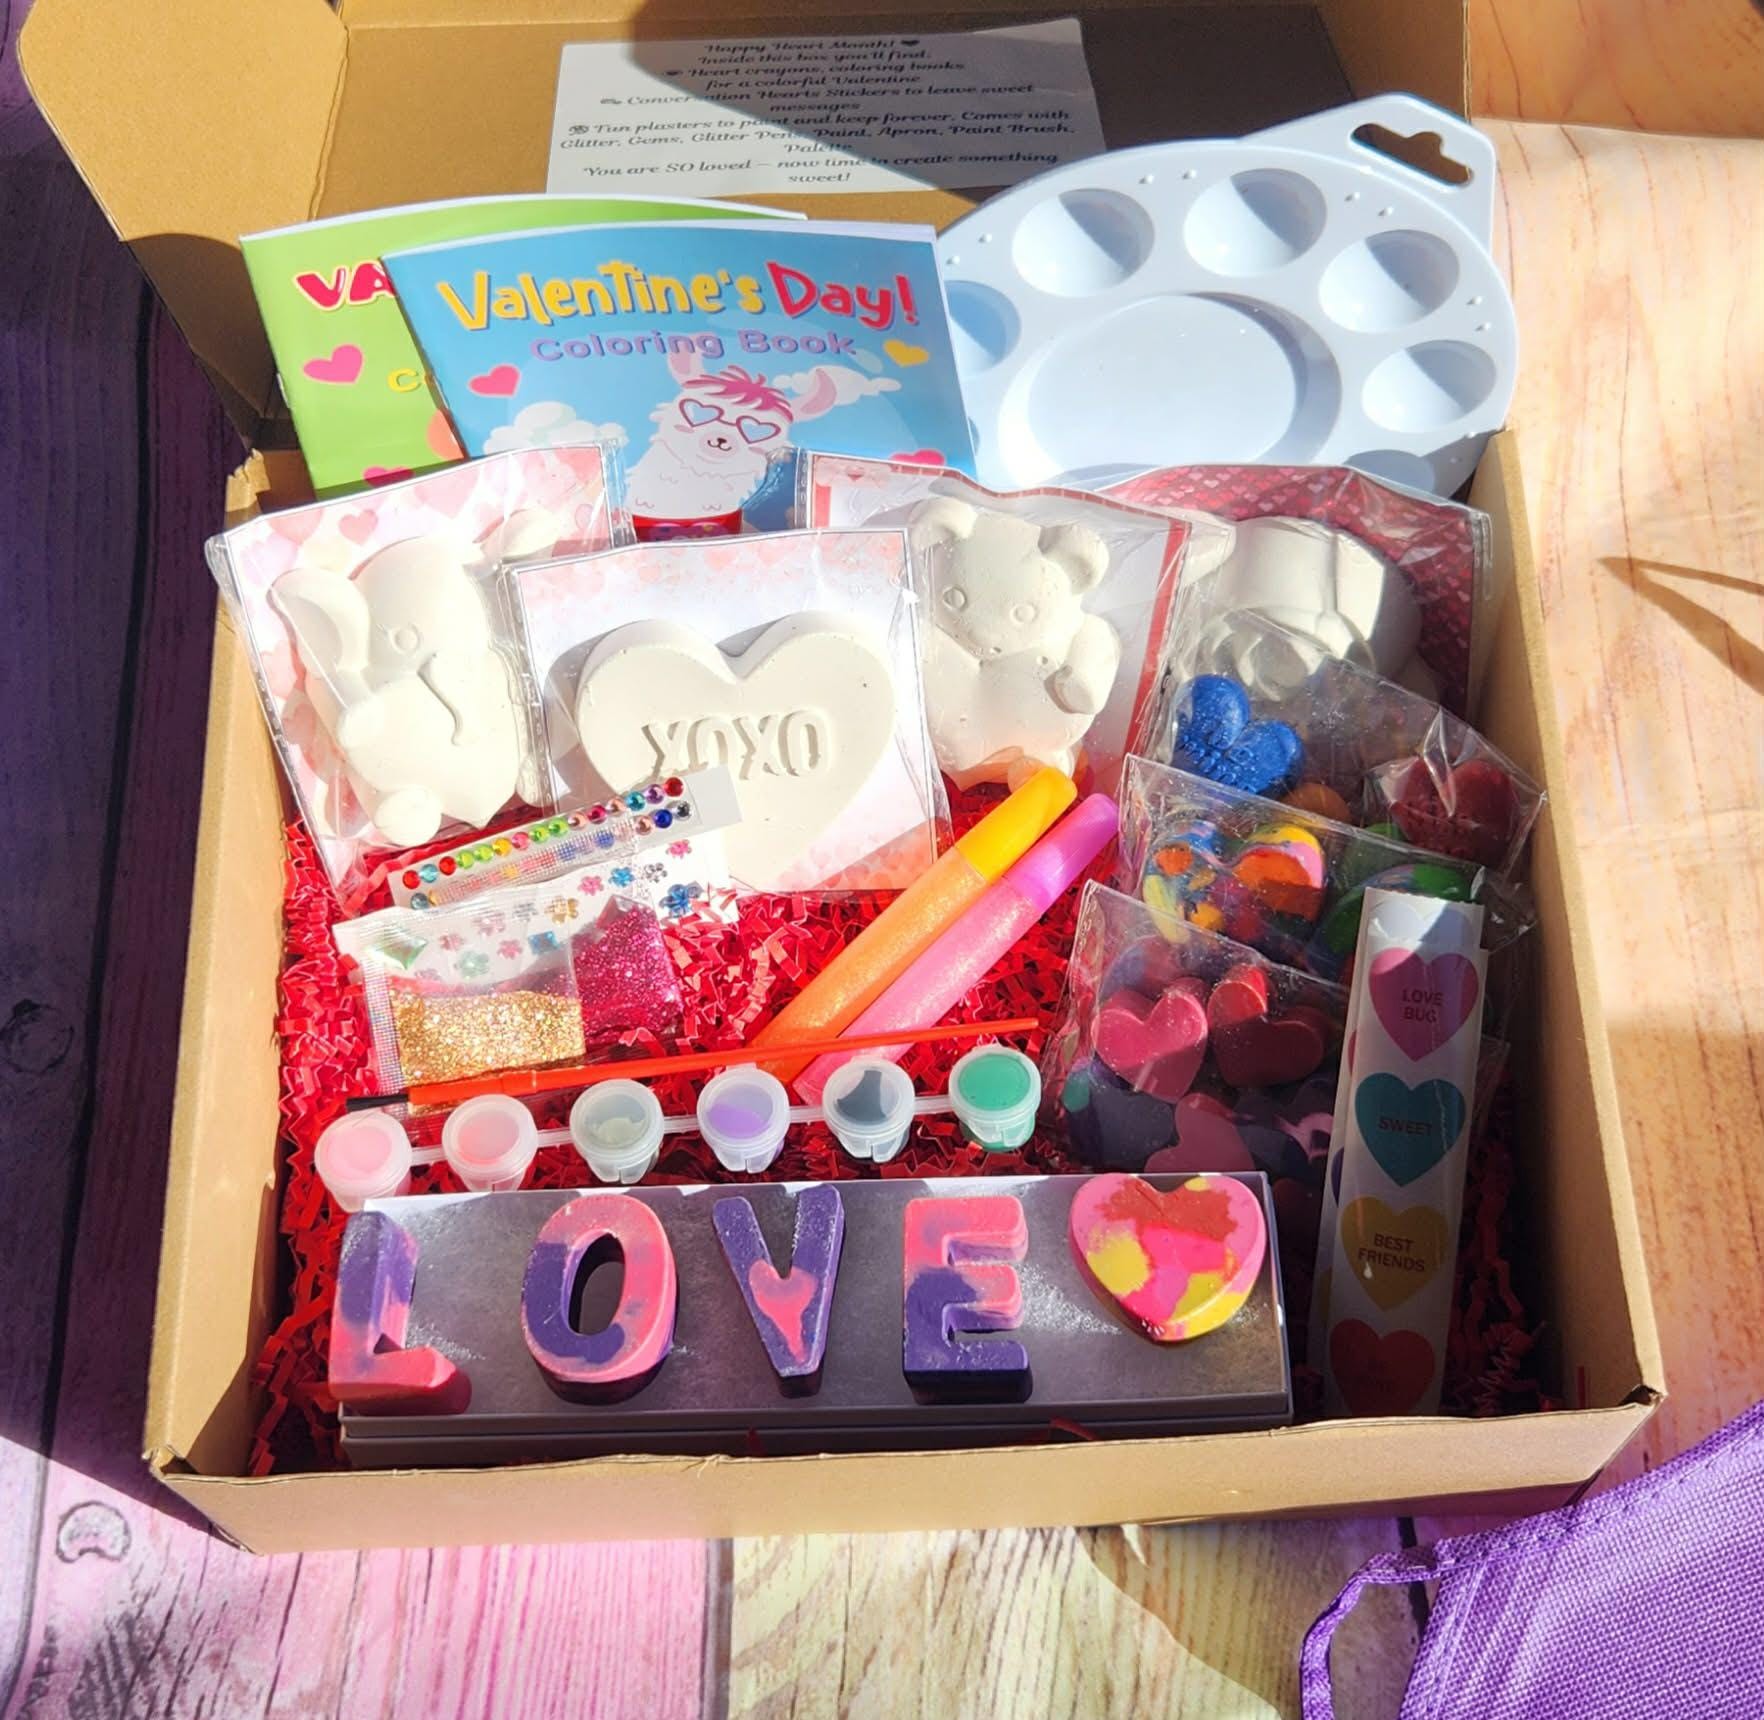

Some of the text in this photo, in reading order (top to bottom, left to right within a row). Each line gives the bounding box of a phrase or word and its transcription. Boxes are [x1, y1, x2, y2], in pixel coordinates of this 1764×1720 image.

[705, 44, 766, 54] Happy
[760, 53, 792, 61] this
[688, 67, 740, 77] Heart
[829, 63, 905, 73] coloring
[910, 61, 965, 70] books
[705, 80, 733, 91] for
[754, 77, 827, 88] colorful
[831, 75, 921, 84] Valentine
[627, 83, 1034, 105] Converation Hearts Stickers to leave sweet
[770, 103, 861, 112] messages
[635, 121, 712, 134] plasters
[793, 114, 831, 124] and
[835, 114, 879, 125] keep
[961, 111, 1023, 121] Comes
[1028, 109, 1071, 120] with
[691, 132, 750, 142] Glitter
[948, 124, 1004, 134] Paint
[583, 166, 622, 176] You
[626, 166, 660, 174] are
[665, 162, 695, 173] SO
[699, 159, 752, 171] loved
[777, 160, 819, 169] now
[825, 158, 866, 167] time
[893, 154, 953, 165] create
[958, 151, 1059, 164] something
[789, 172, 850, 182] sweet!
[438, 259, 918, 331] Valentine's Day!
[529, 328, 858, 361] Coloring Book
[1401, 988, 1444, 1006] LOVE
[1403, 1006, 1438, 1024] BUG
[1377, 1116, 1433, 1136] SWEET
[1373, 1232, 1416, 1250] BEST
[1357, 1247, 1426, 1272] FRIENDS
[328, 1183, 1034, 1406] LOVE
